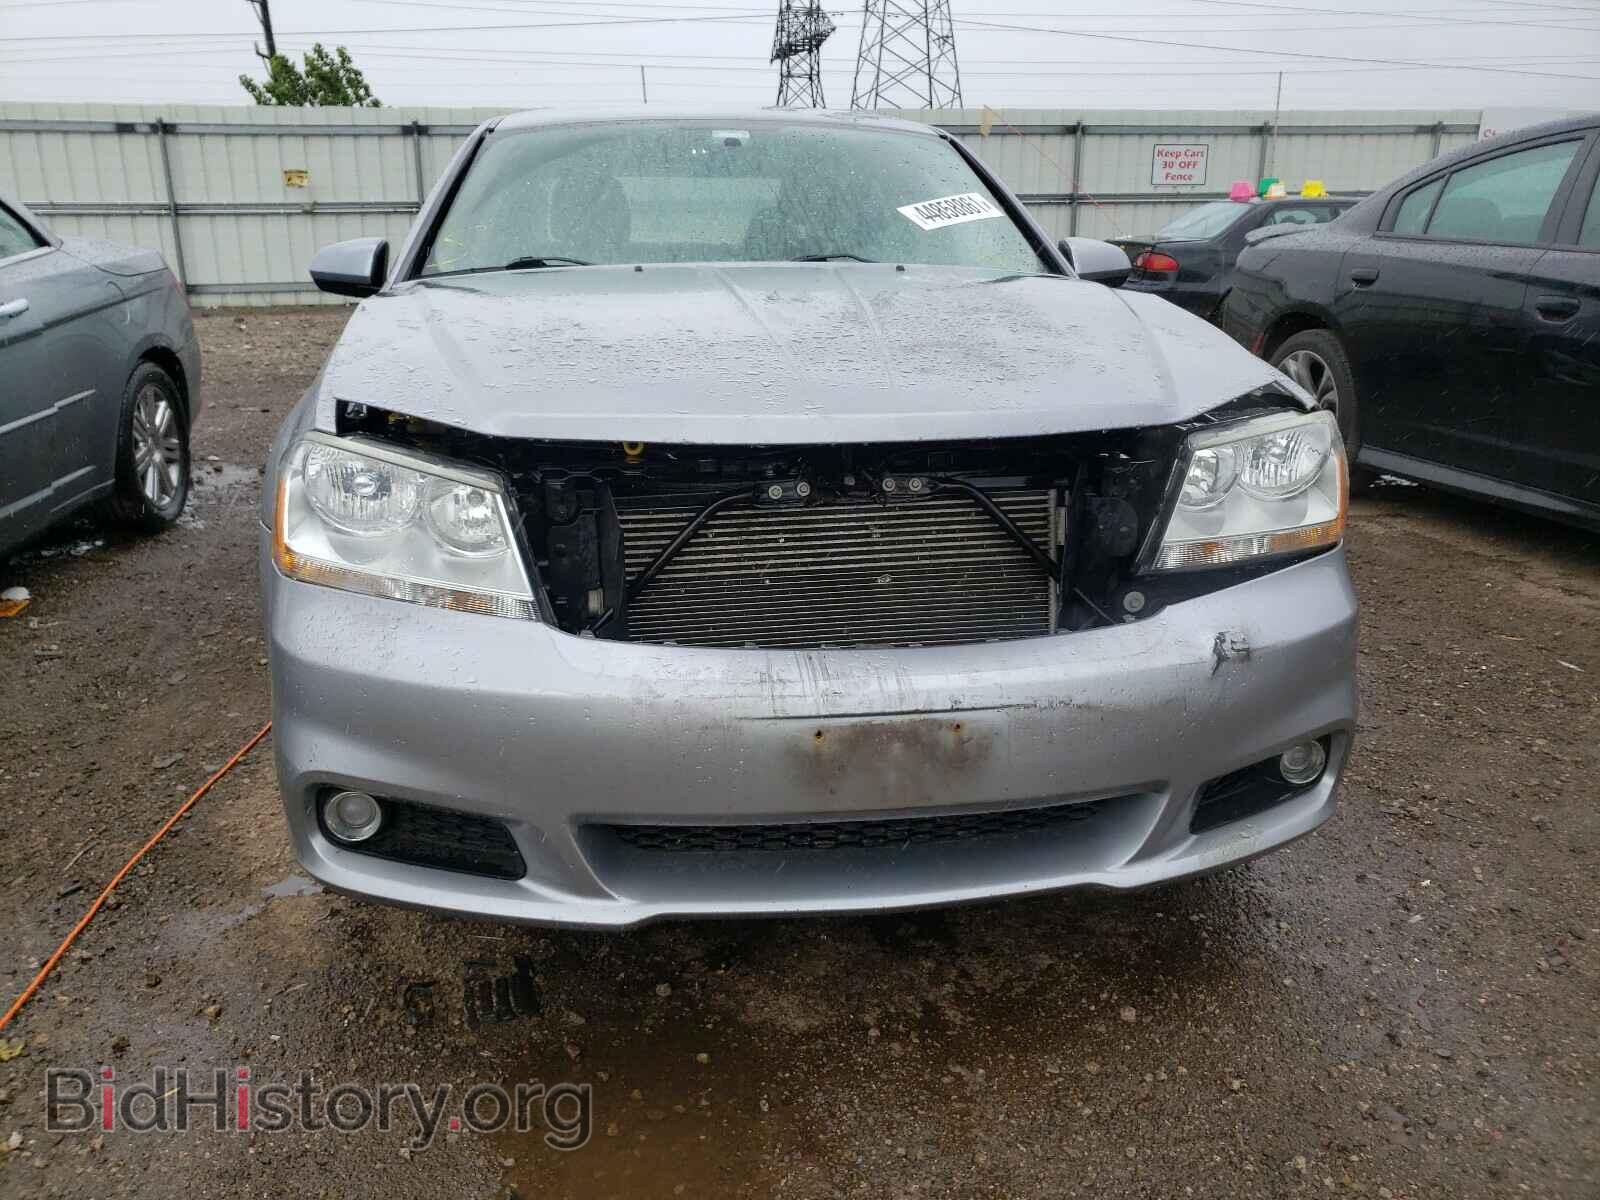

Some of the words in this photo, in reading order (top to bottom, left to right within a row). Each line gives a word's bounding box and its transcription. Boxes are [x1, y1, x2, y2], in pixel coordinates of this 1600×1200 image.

[1157, 148, 1181, 159] Keep
[1179, 160, 1200, 169] OFF
[1165, 172, 1193, 181] Fence
